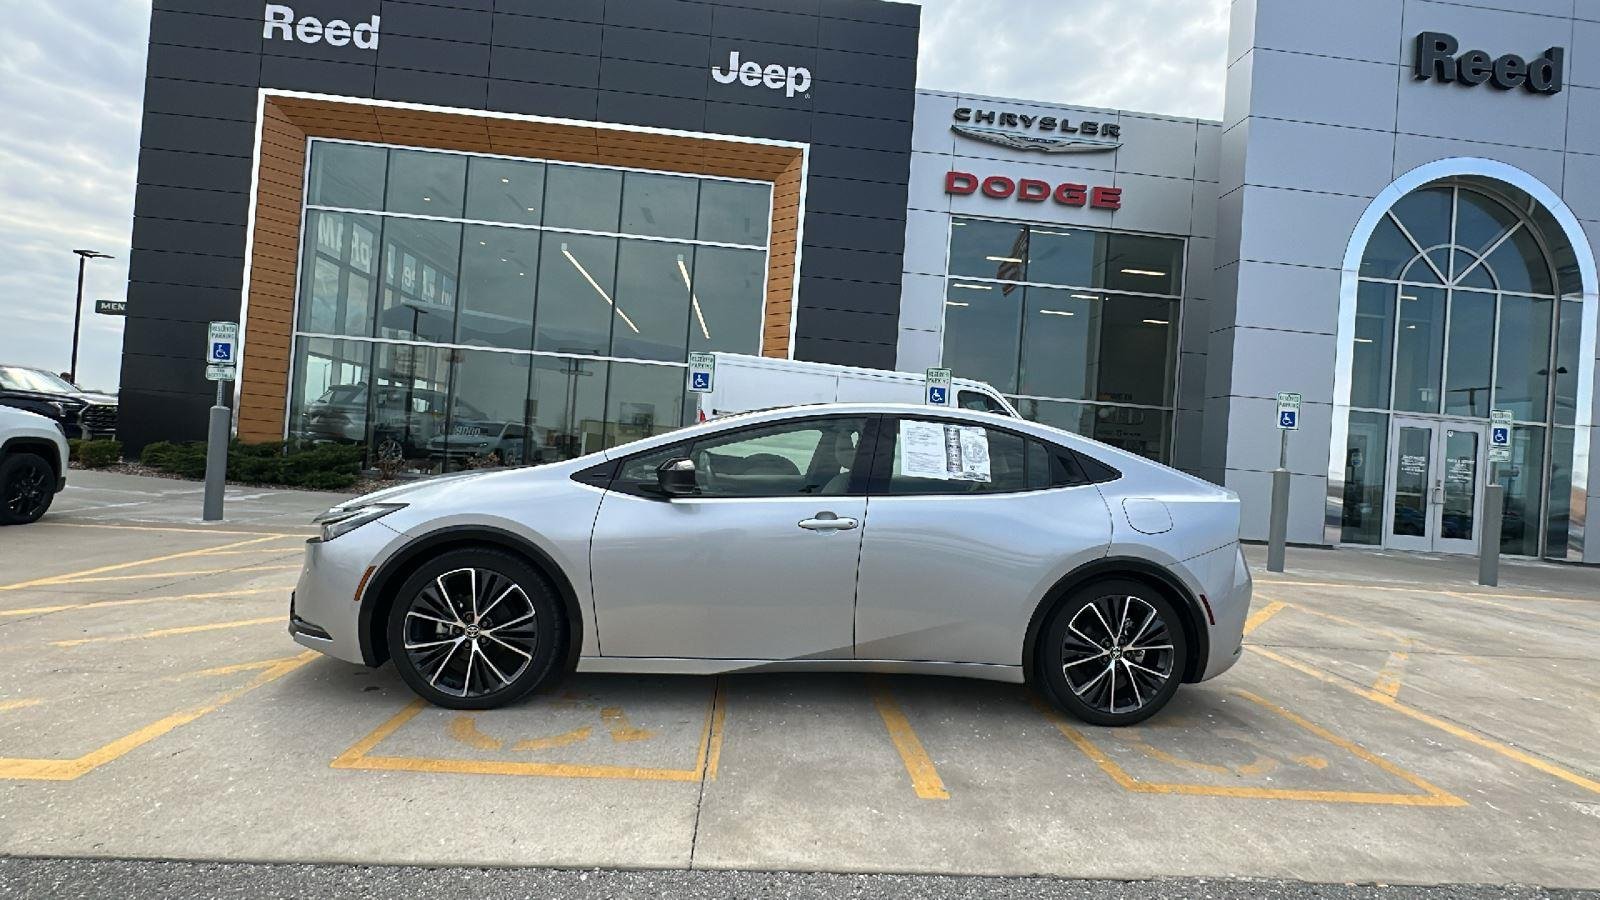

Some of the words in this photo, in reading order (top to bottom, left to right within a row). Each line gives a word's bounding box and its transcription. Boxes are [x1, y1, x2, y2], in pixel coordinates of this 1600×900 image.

[263, 4, 380, 50] Reed
[712, 51, 811, 97] Jeep
[1415, 31, 1564, 95] Reed
[954, 107, 1121, 136] CHRYSLER
[945, 171, 1122, 210] DODGE
